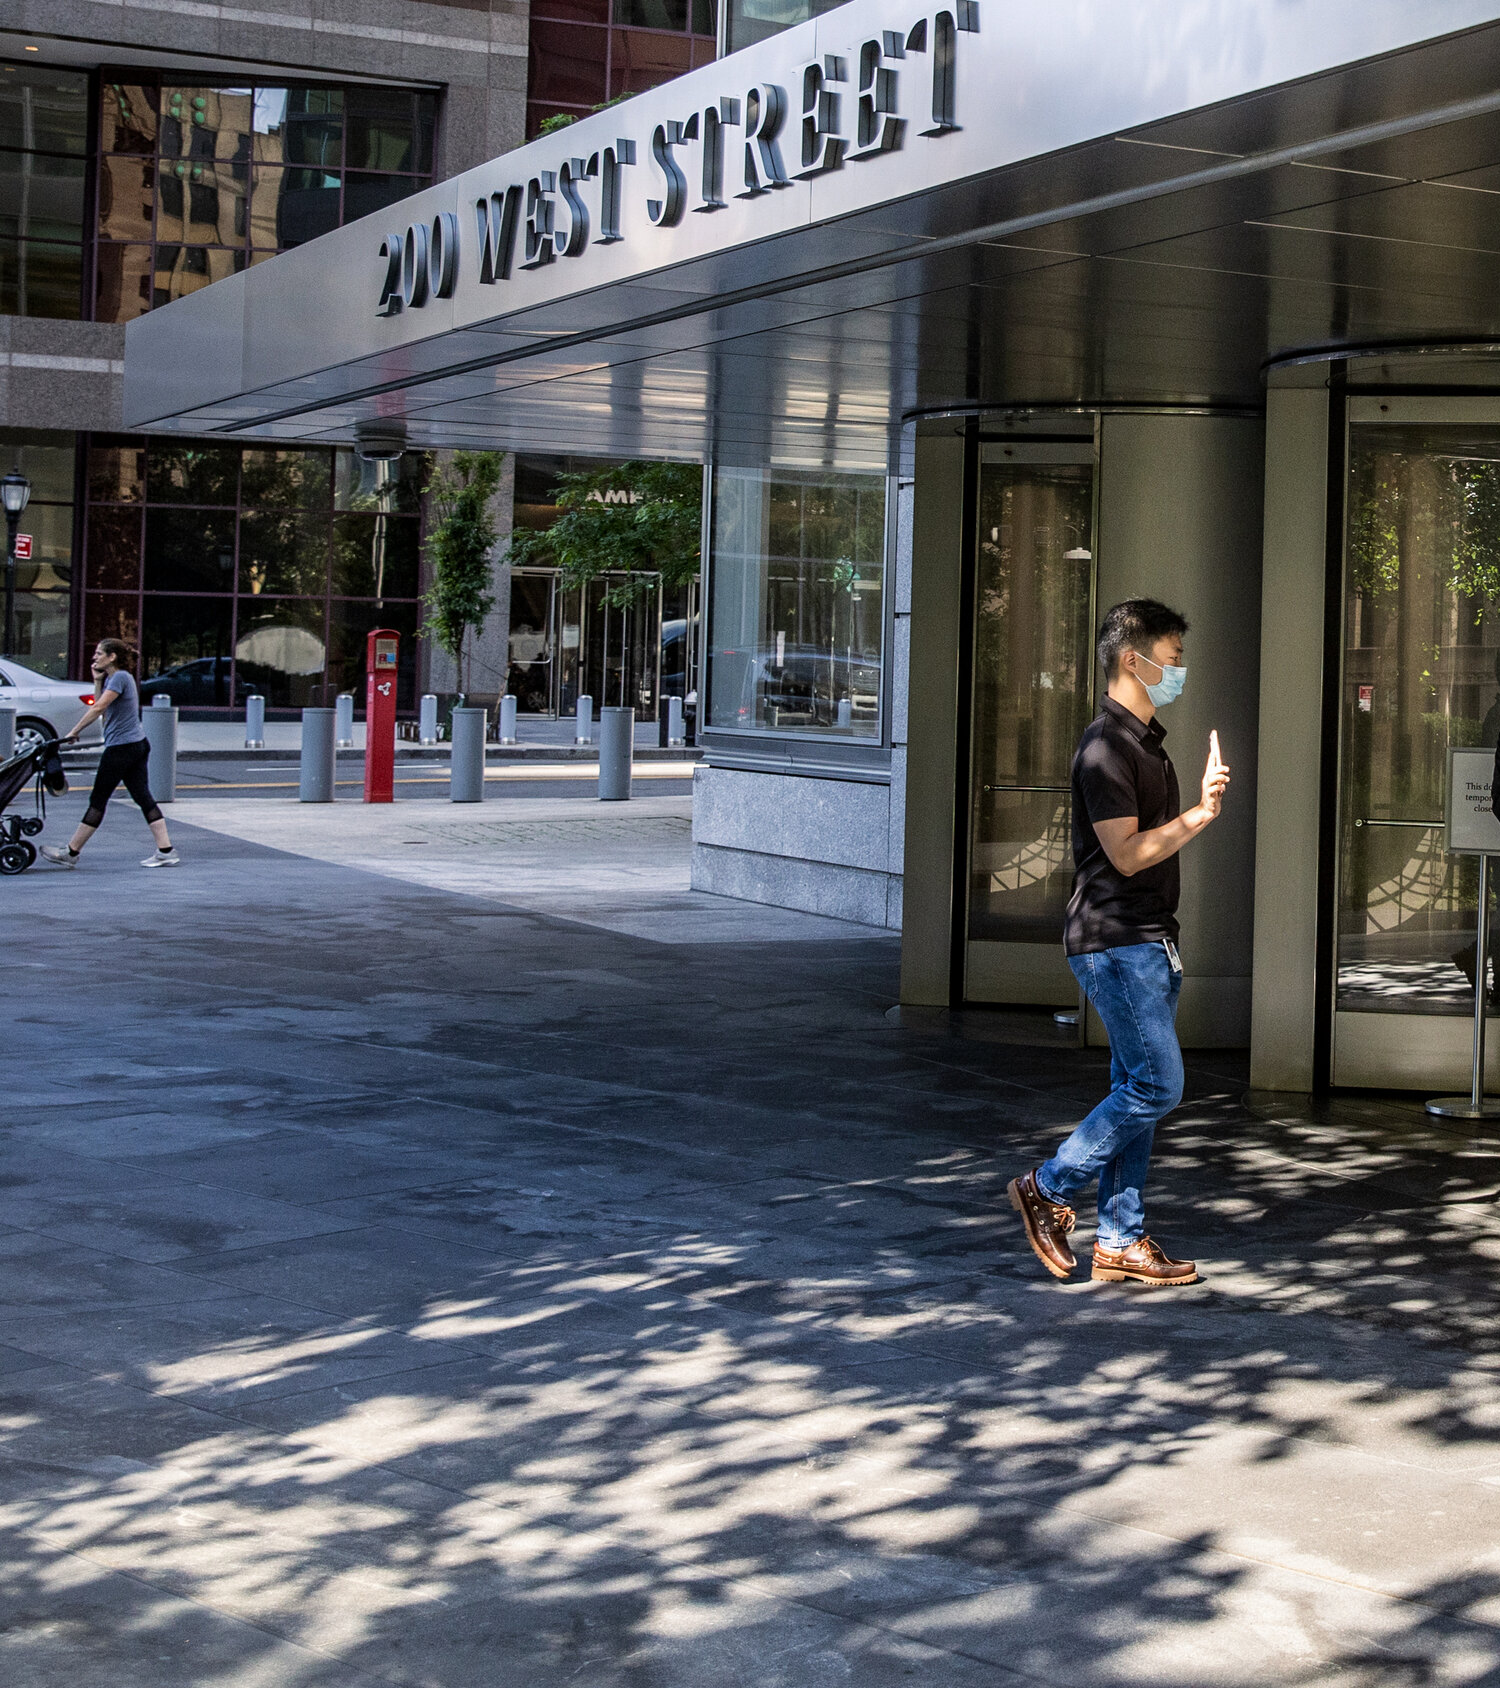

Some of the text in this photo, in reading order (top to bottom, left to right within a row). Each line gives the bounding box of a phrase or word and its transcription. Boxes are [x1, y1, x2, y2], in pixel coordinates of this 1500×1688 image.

[375, 0, 981, 318] 200 WEST STREET
[1465, 782, 1493, 791] This do
[1465, 794, 1492, 803] tempor
[1473, 804, 1493, 812] close
